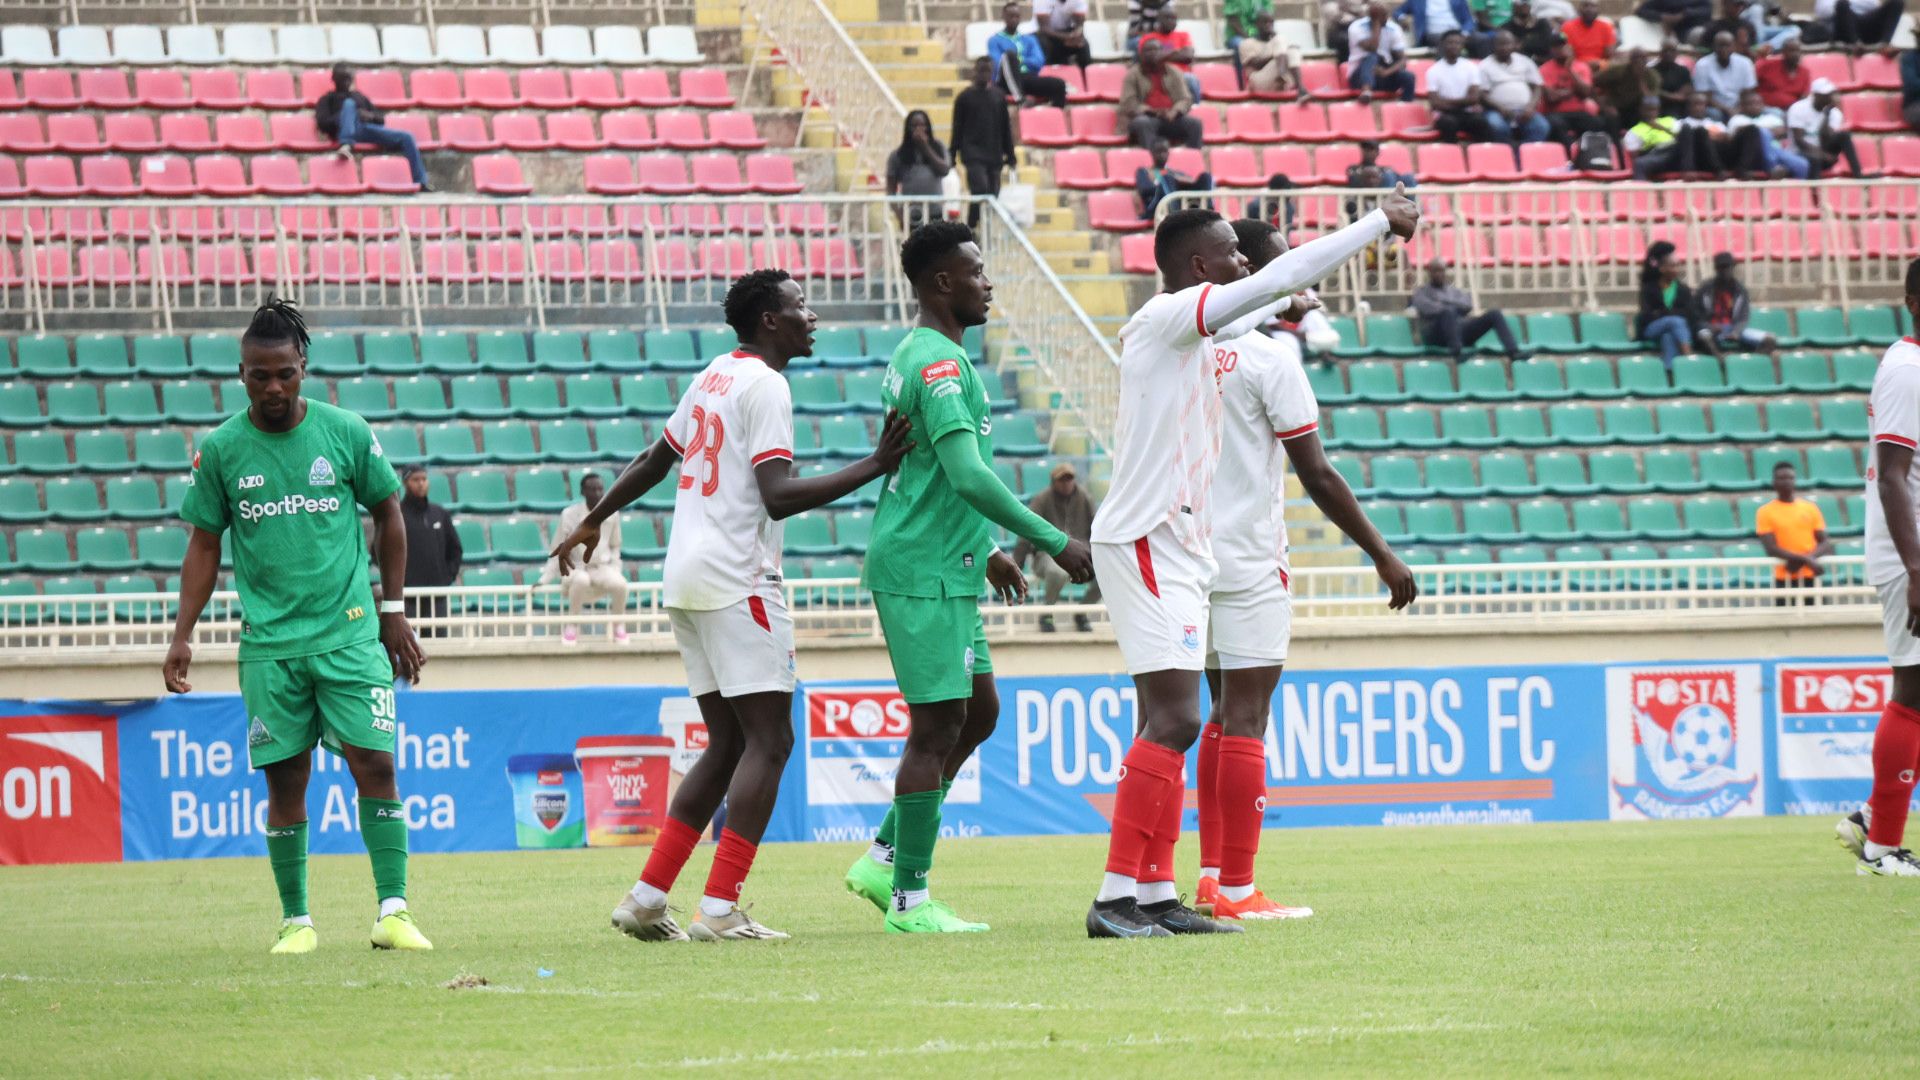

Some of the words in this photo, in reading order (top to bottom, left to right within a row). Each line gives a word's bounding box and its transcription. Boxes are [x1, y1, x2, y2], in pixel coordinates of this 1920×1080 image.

[679, 404, 725, 497] 28
[238, 494, 340, 523] SportPesa
[370, 687, 396, 719] 30
[1636, 678, 1732, 708] POSTA
[1794, 674, 1894, 710] POST
[824, 698, 911, 736] POS
[1264, 678, 1466, 781] NGERS
[1487, 675, 1556, 774] FC
[151, 729, 233, 778] The
[397, 722, 471, 770] hat
[0, 765, 72, 820] on
[606, 774, 649, 789] VINYL
